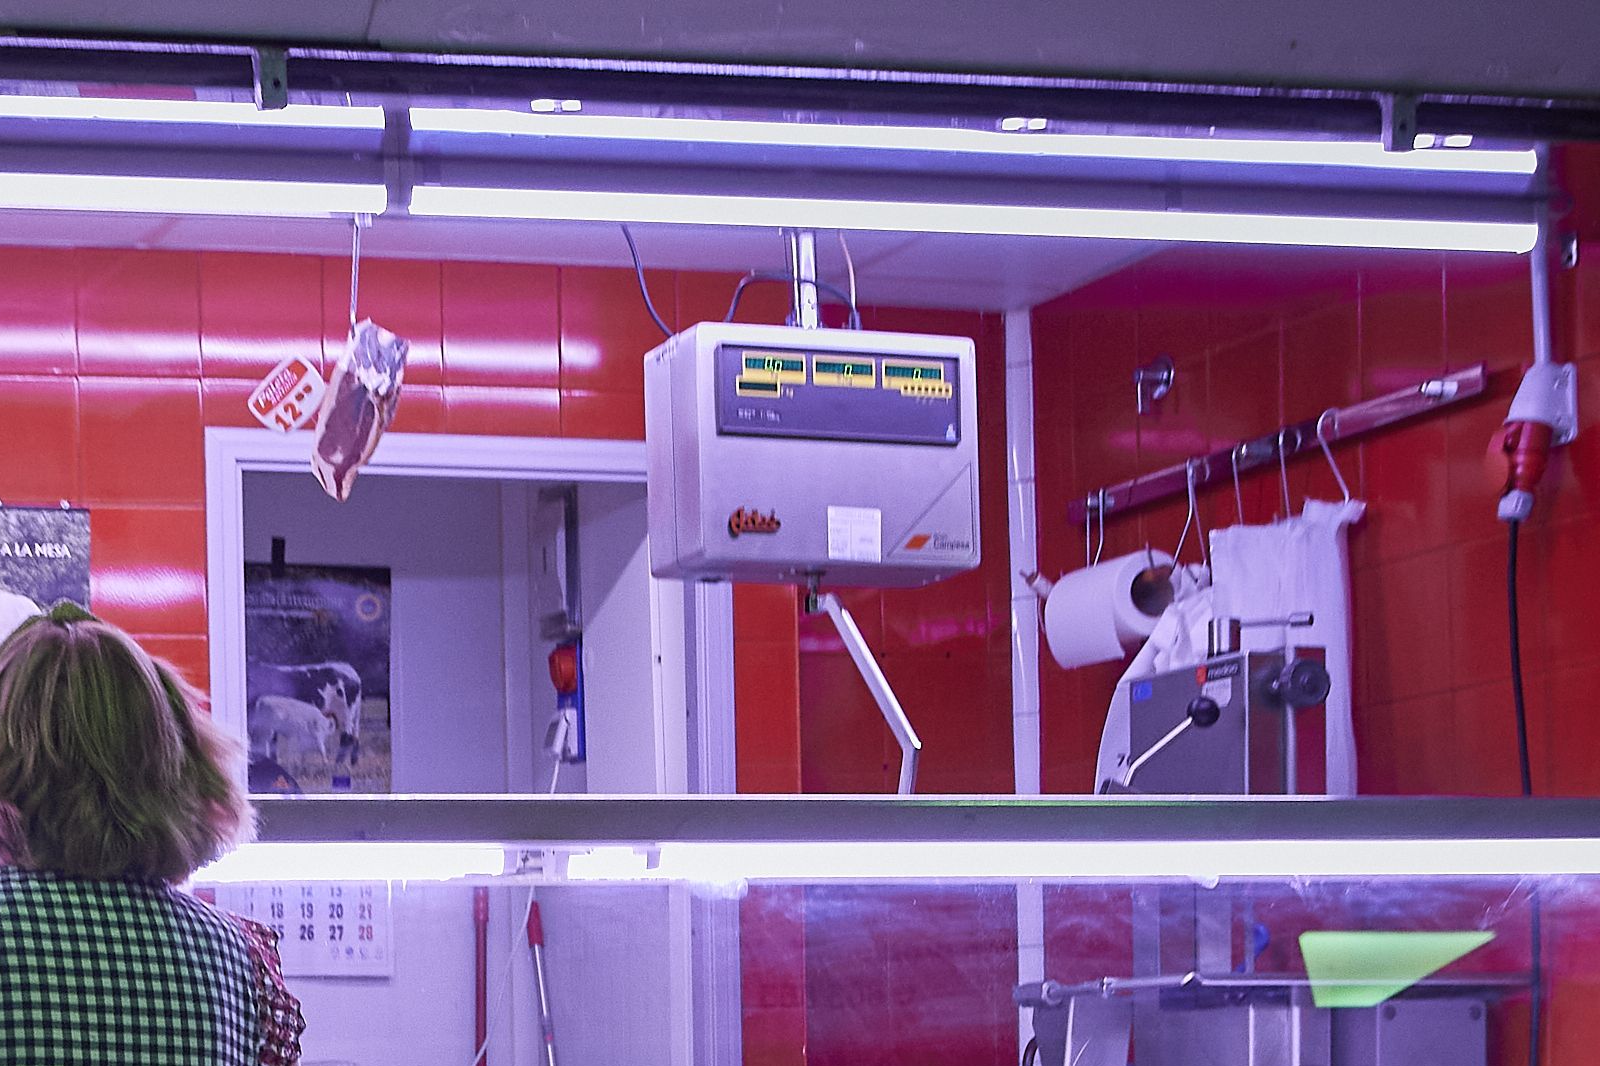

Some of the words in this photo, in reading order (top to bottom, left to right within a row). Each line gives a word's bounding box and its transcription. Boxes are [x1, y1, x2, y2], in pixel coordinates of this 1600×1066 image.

[0, 543, 12, 557] A
[14, 543, 32, 558] LA
[34, 543, 71, 558] MESA
[271, 902, 284, 919] 18
[300, 902, 314, 919] 19
[329, 903, 343, 919] 20
[359, 903, 372, 919] 21
[300, 924, 314, 940] 26
[329, 924, 343, 940] 27
[359, 924, 373, 940] 28
